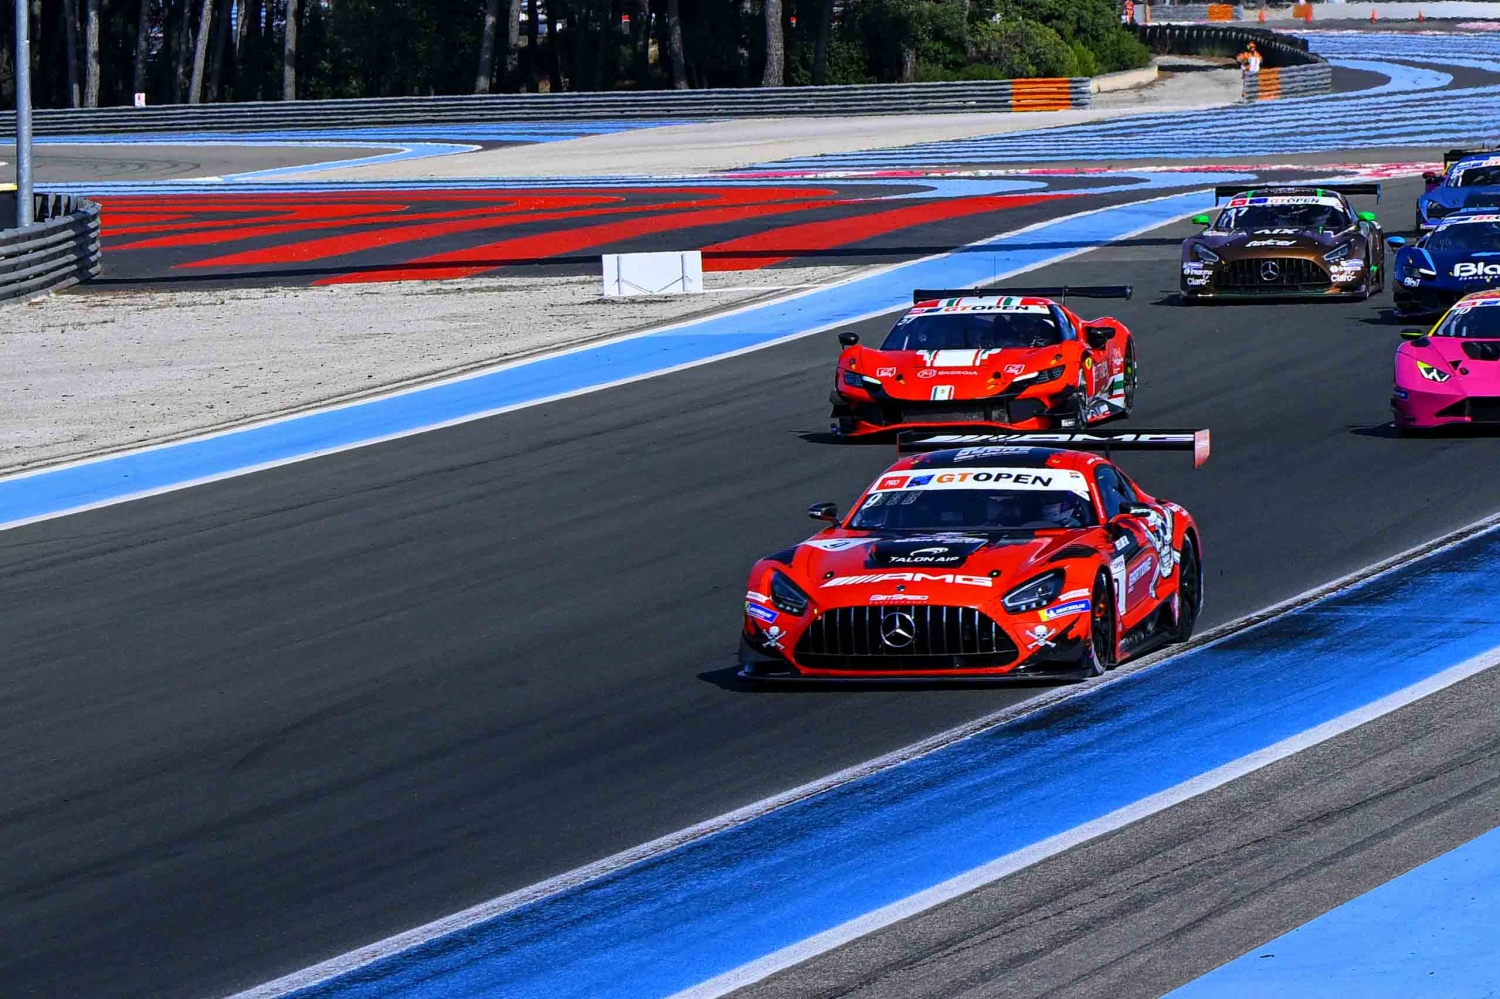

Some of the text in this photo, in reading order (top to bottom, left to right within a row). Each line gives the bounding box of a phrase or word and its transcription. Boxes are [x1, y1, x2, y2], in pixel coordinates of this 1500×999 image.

[944, 305, 1030, 313] GTOPEN
[936, 472, 1053, 487] GTOPEN
[870, 572, 993, 588] AMG
